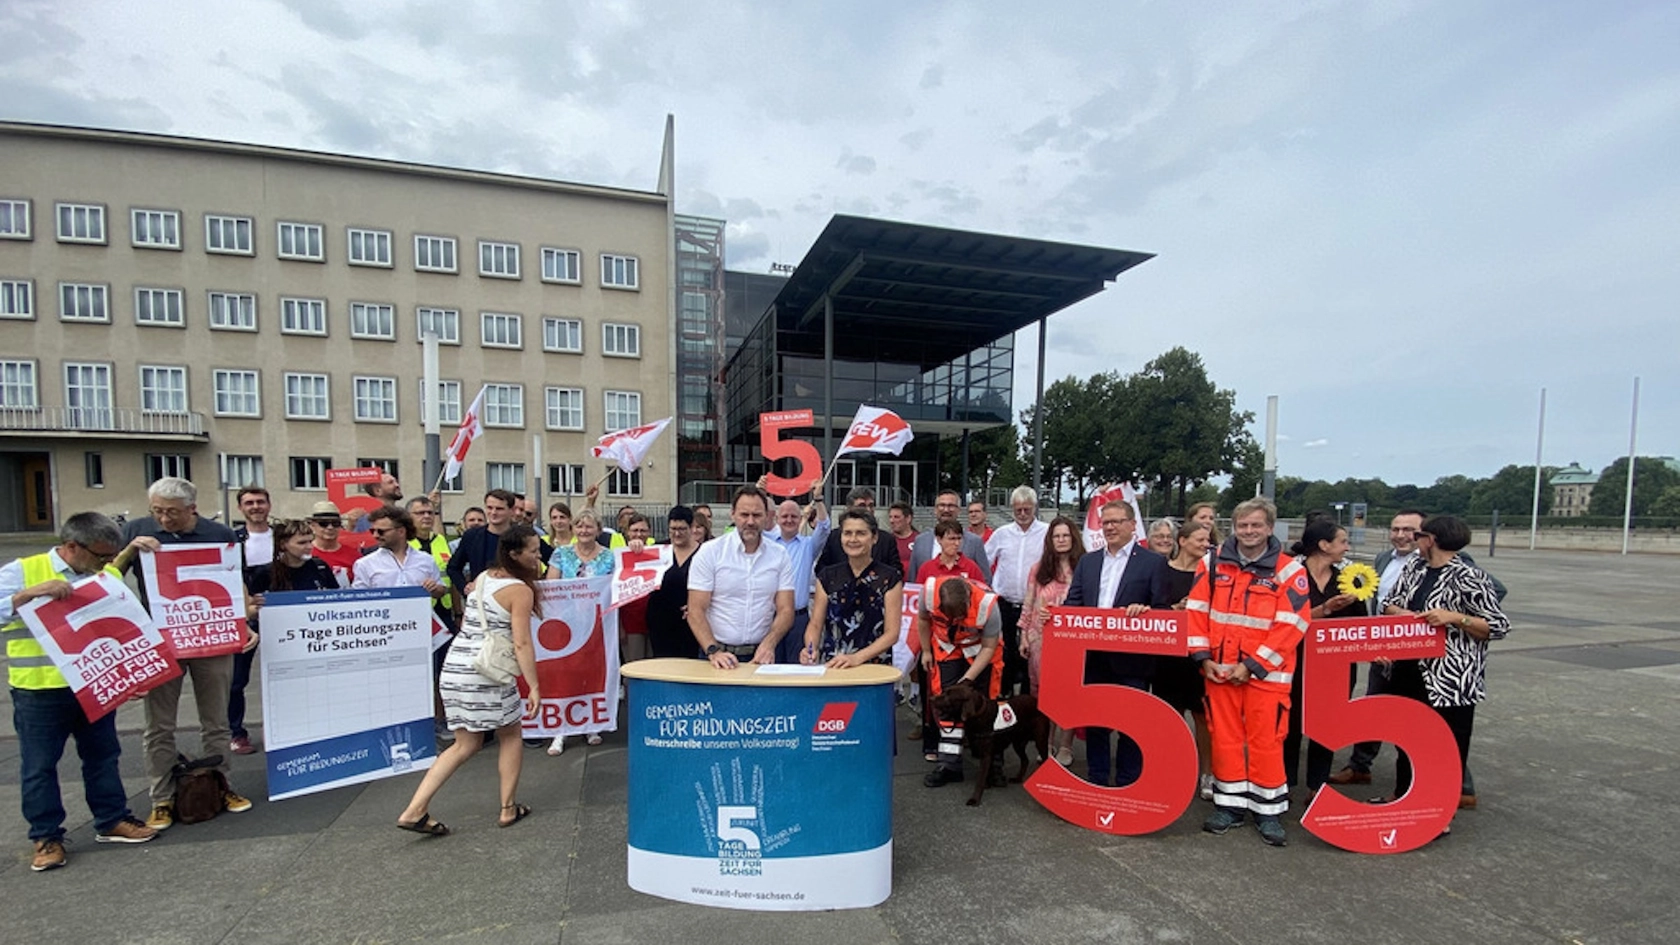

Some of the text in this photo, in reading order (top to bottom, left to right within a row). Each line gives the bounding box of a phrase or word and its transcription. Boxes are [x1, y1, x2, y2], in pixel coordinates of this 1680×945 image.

[760, 408, 823, 497] 5
[619, 548, 660, 581] 5
[154, 547, 233, 608] 5
[617, 577, 641, 592] TAGE
[542, 583, 589, 593] werkschaft
[571, 591, 601, 602] Energie
[162, 600, 204, 614] TAGE
[307, 608, 390, 623] Volksantrag
[34, 580, 144, 655] 5
[166, 608, 235, 626] BILDUNG
[1053, 614, 1178, 633] 5 TAGE BILDUNG
[169, 619, 237, 638] ZEIT FÜR
[299, 628, 332, 642] Tage
[336, 620, 418, 637] Bildungszeit
[1053, 630, 1178, 645] www.zeit-fuer-sachsen.de
[1316, 623, 1437, 643] 5 TAGE BILDUNG
[174, 631, 241, 649] SACHSEN
[307, 641, 328, 654] für
[1316, 639, 1437, 654] www.zeit-fuer-sachsen.de
[72, 641, 112, 670] TAGE
[80, 637, 151, 682] BILDUNG
[89, 648, 160, 695] ZEIT FÜR
[96, 658, 169, 705] SACHSEN
[645, 701, 714, 720] GEMEINSAM
[659, 715, 797, 738] FÜR BILDUNGSZEIT
[818, 719, 845, 732] DGB
[1023, 605, 1200, 836] 5
[643, 736, 800, 750] Unterschreibe unseren Volksantrag!
[1300, 616, 1463, 855] 5
[390, 742, 411, 760] 5
[717, 805, 761, 850] 5
[717, 841, 744, 850] TAGE
[718, 849, 762, 858] BILDUNG
[719, 860, 740, 868] ZEIT
[719, 868, 762, 877] SACHSEN
[691, 887, 805, 901] www.zeit-fuer-sachsen.de
